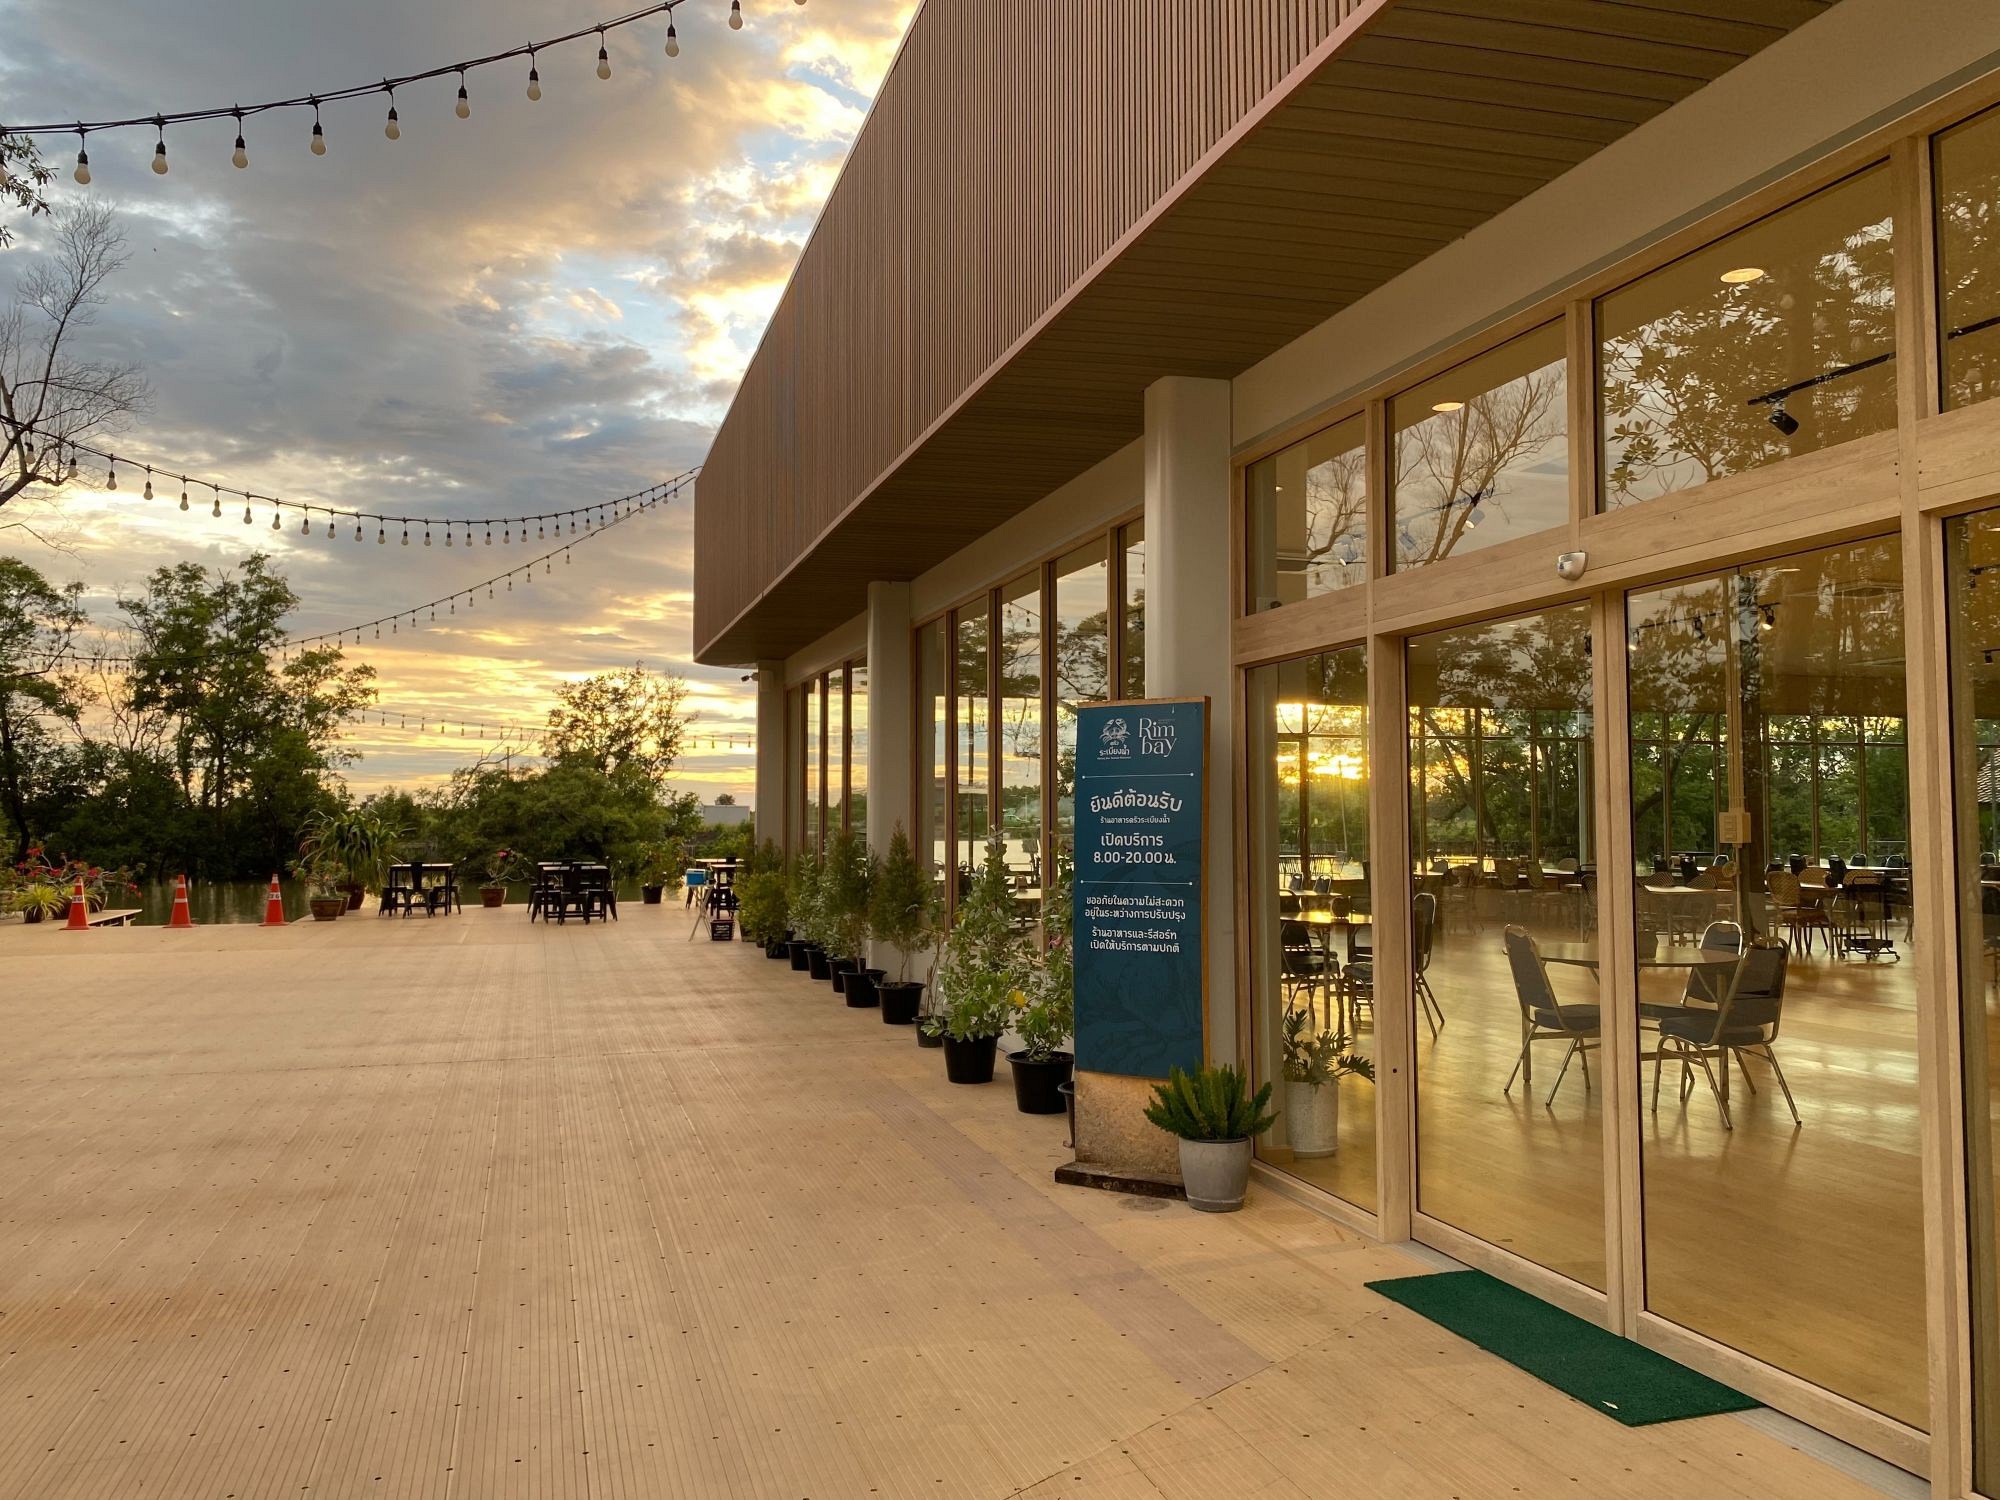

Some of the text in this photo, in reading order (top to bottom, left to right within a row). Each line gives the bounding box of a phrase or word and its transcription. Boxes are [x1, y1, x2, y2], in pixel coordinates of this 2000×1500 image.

[1139, 718, 1174, 738] Rim
[1142, 736, 1177, 757] bay
[1090, 788, 1182, 813] ยินดีต้อนรับ
[1101, 832, 1164, 846] เปิดบริการ
[1086, 894, 1184, 907] ขออภัยในความไม่สะดวก
[1084, 906, 1186, 923] อยู่ในระหว่างการปรับปรุง
[1092, 926, 1177, 940] ร้านอาหารและรีสอร์ท
[1090, 939, 1180, 953] เปิดให้บริการตามปกติ
